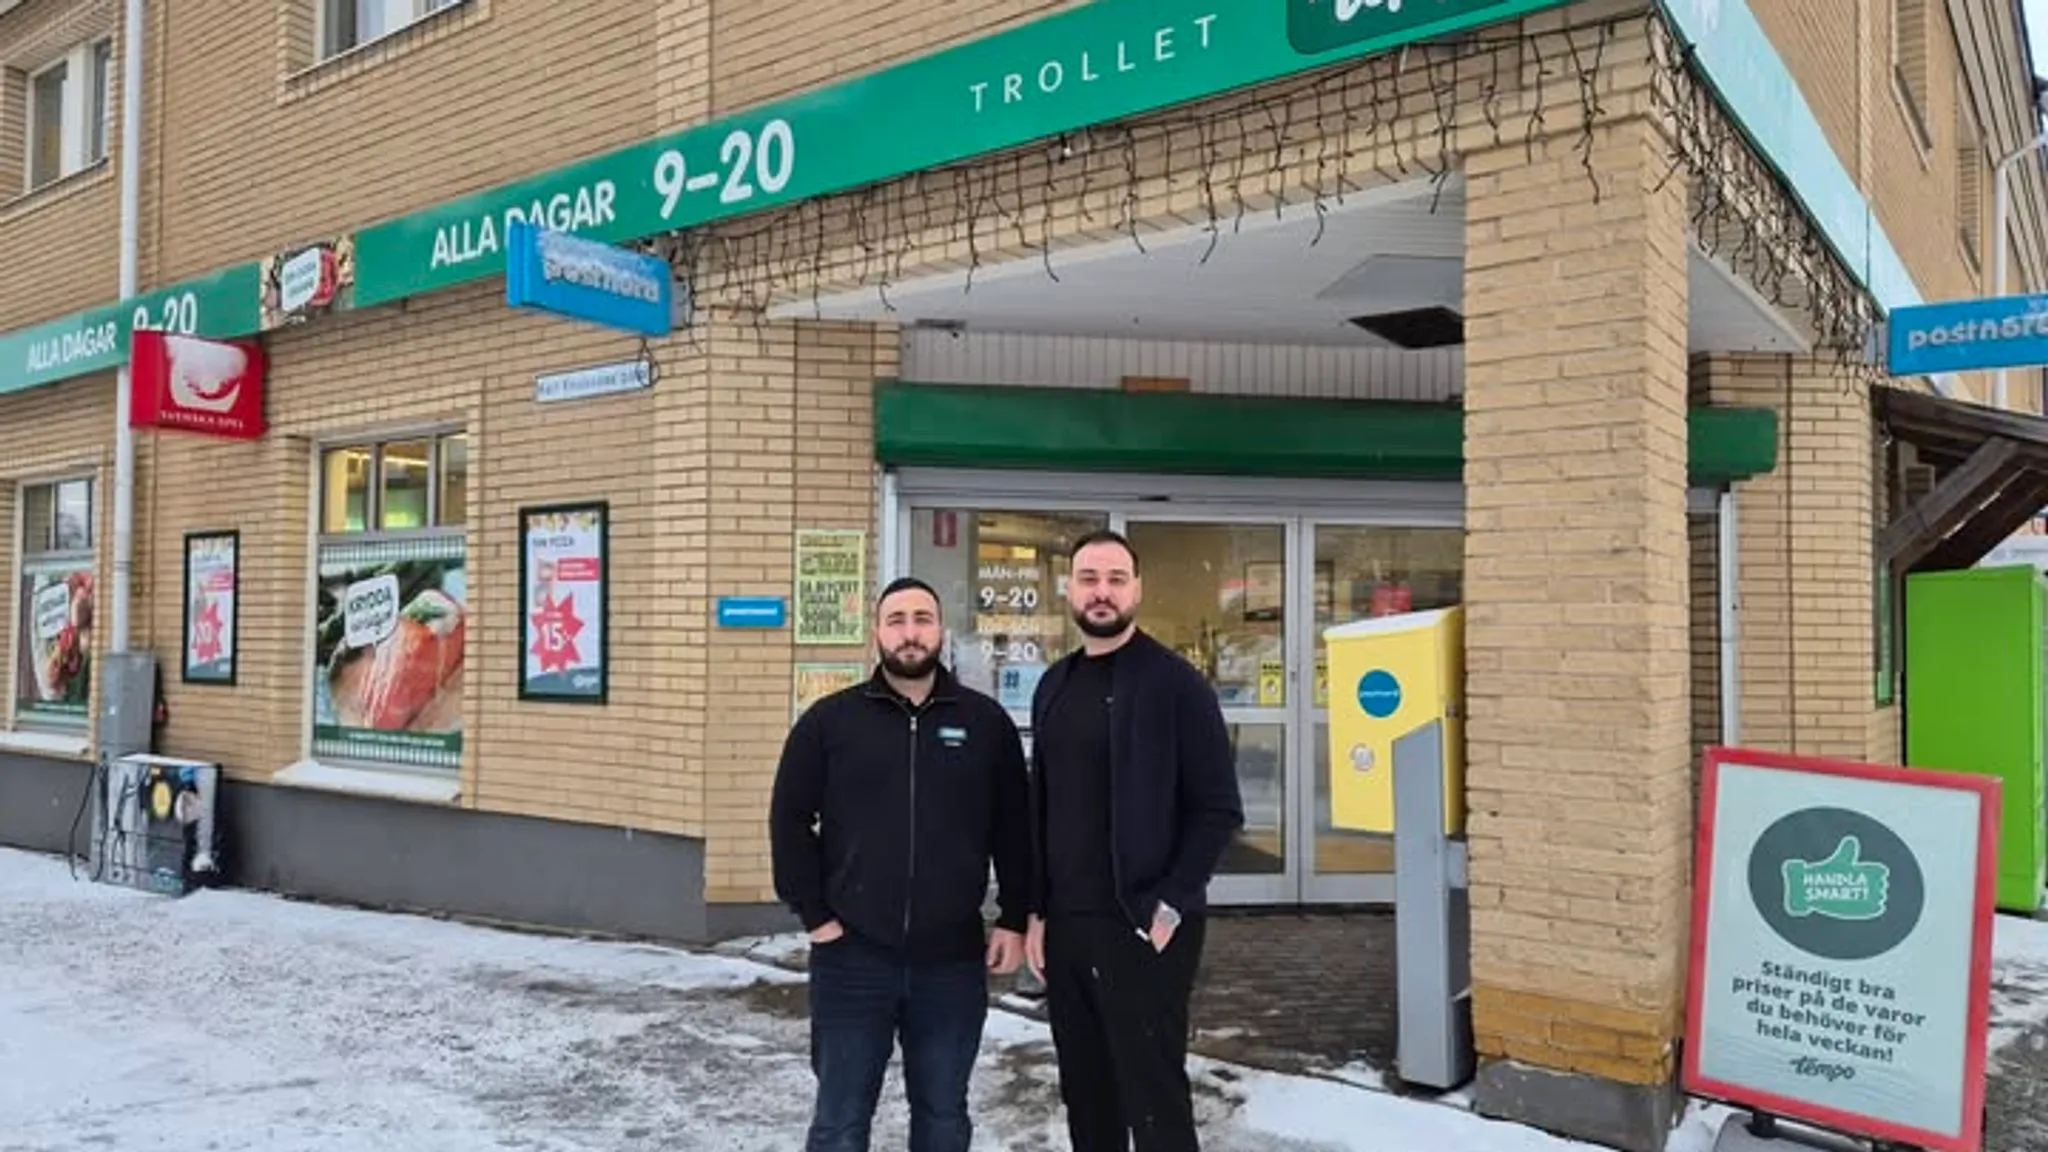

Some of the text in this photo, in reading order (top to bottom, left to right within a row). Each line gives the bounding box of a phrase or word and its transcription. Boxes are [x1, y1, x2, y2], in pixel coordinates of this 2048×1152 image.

[969, 14, 1218, 112] TROLLET
[431, 215, 498, 269] ALLA
[653, 119, 794, 219] 9–20
[26, 338, 60, 373] ALLA
[62, 321, 118, 362] DAGAR
[980, 586, 1038, 608] 9–20
[980, 641, 1038, 664] 9–20
[1803, 872, 1868, 886] HANDLA
[1805, 886, 1870, 901] SMART!
[1761, 960, 1896, 1000] Ständigt bra
[1732, 976, 1927, 1027] priser på de varor
[1746, 998, 1907, 1046] du behöver för
[1756, 1019, 1894, 1063] hela veckan!
[1789, 1055, 1856, 1082] tempo
